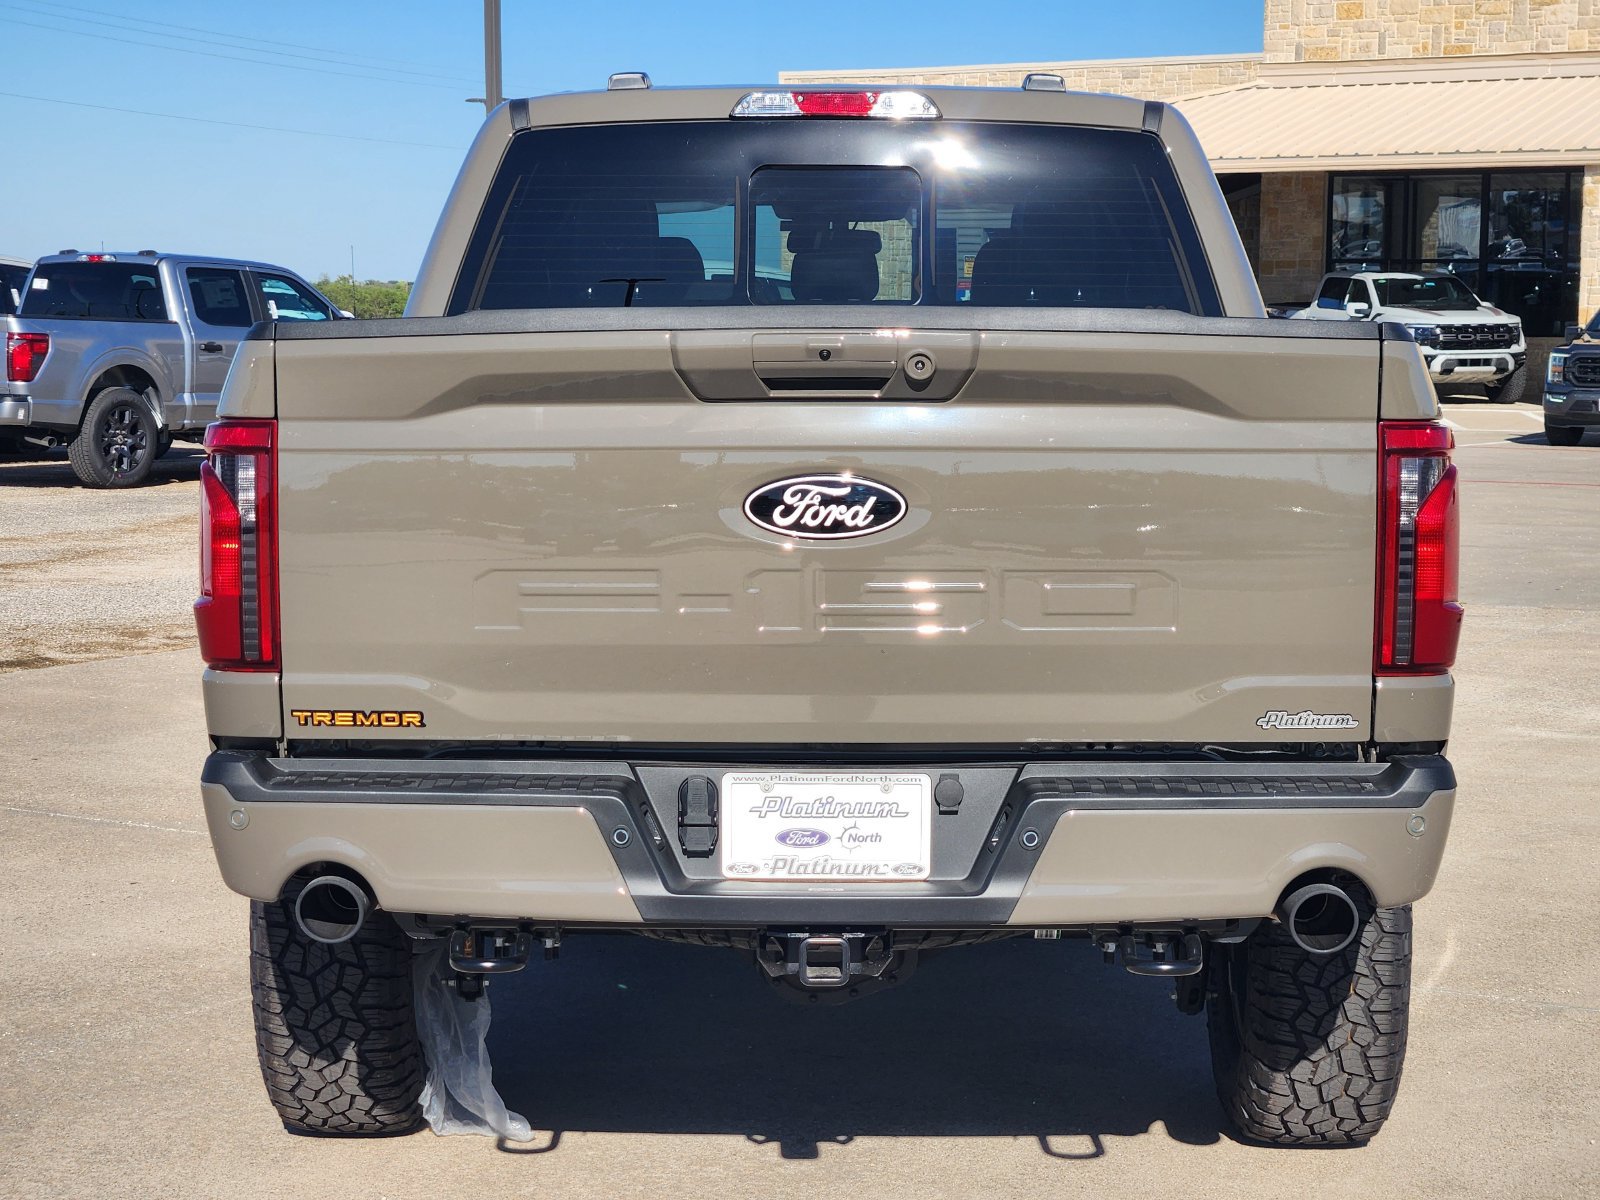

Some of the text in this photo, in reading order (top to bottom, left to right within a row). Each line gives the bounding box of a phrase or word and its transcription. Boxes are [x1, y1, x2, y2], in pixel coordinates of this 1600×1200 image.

[1439, 333, 1509, 341] FORD
[772, 484, 877, 527] Ford
[291, 709, 426, 727] TREMOR
[1256, 710, 1359, 729] Platinum
[732, 774, 922, 783] www.PlatinumFordNorth.com
[749, 796, 910, 818] Platinum
[785, 829, 820, 846] Ford
[847, 832, 882, 843] North
[768, 857, 887, 876] Platinum
